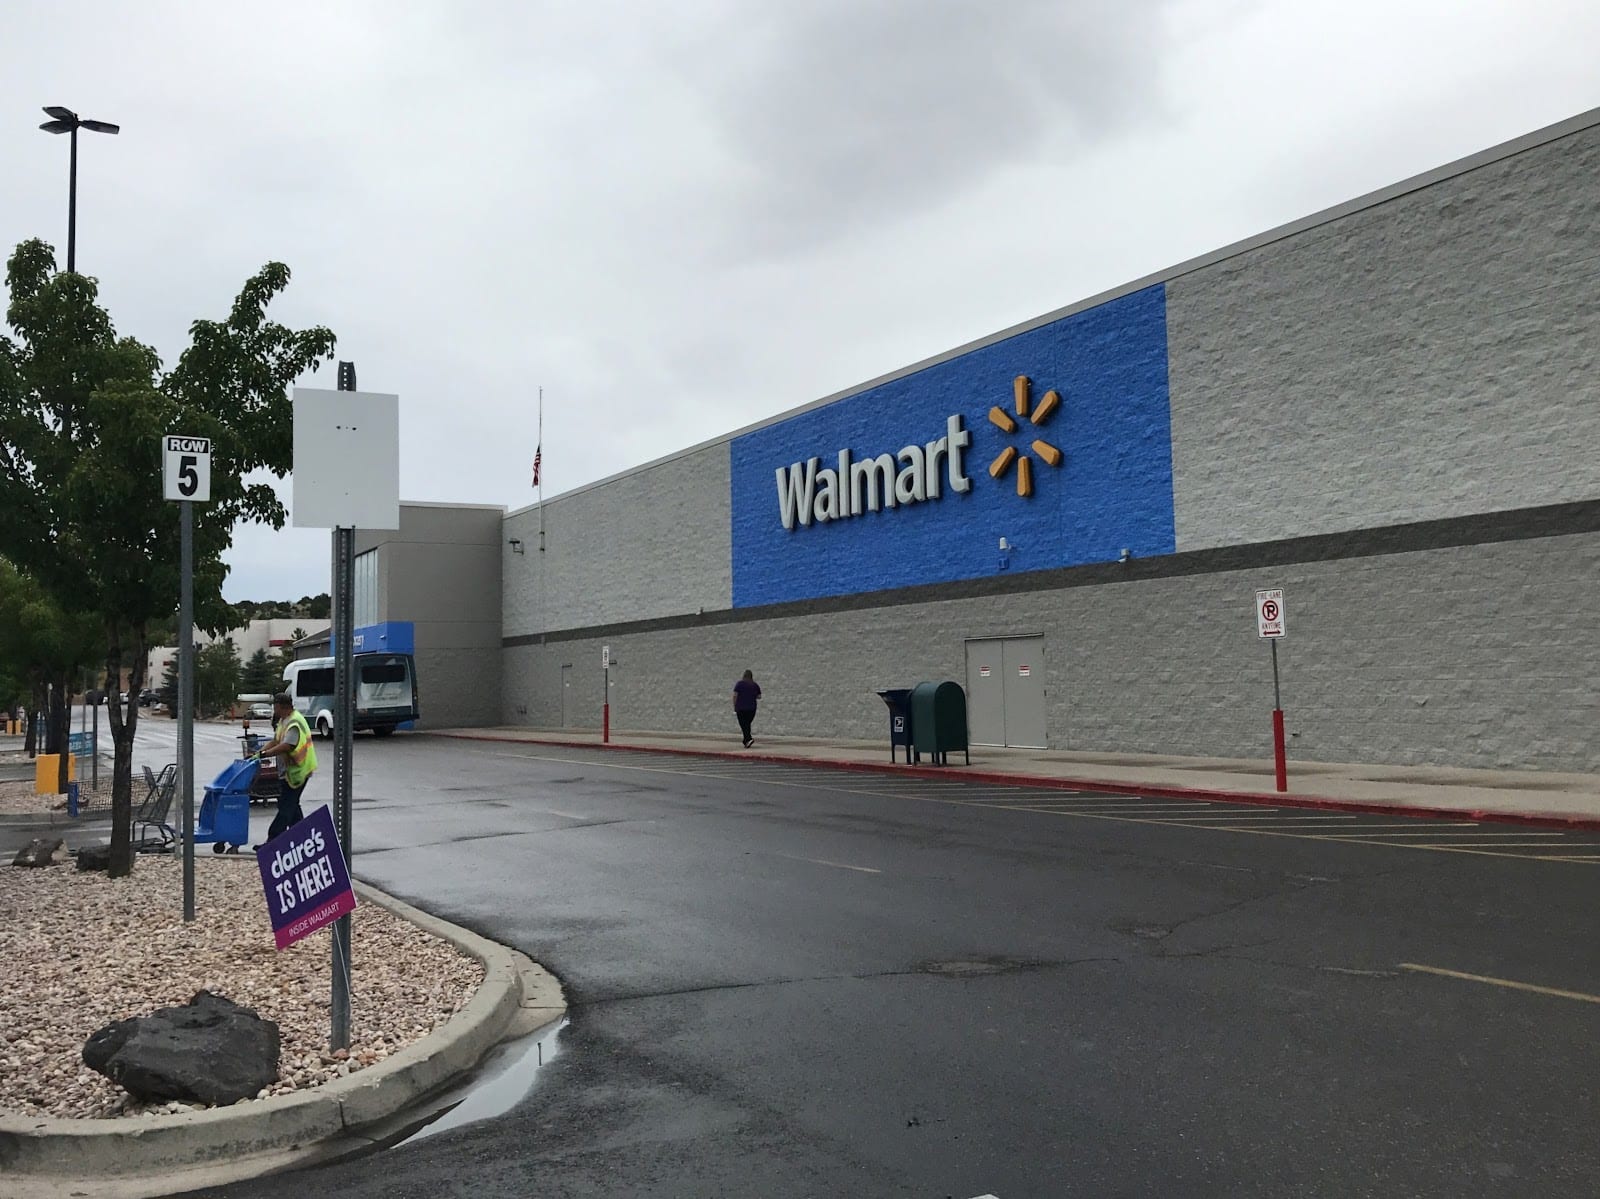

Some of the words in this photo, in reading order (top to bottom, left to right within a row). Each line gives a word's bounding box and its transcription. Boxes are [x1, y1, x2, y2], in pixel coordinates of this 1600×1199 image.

[170, 439, 206, 453] ROW
[178, 456, 198, 496] 5
[775, 413, 970, 530] Walmart
[271, 827, 325, 879] claire's
[275, 878, 296, 914] IS
[294, 854, 336, 903] HERE!
[288, 919, 310, 937] INSIDE
[308, 901, 340, 928] WALMART
